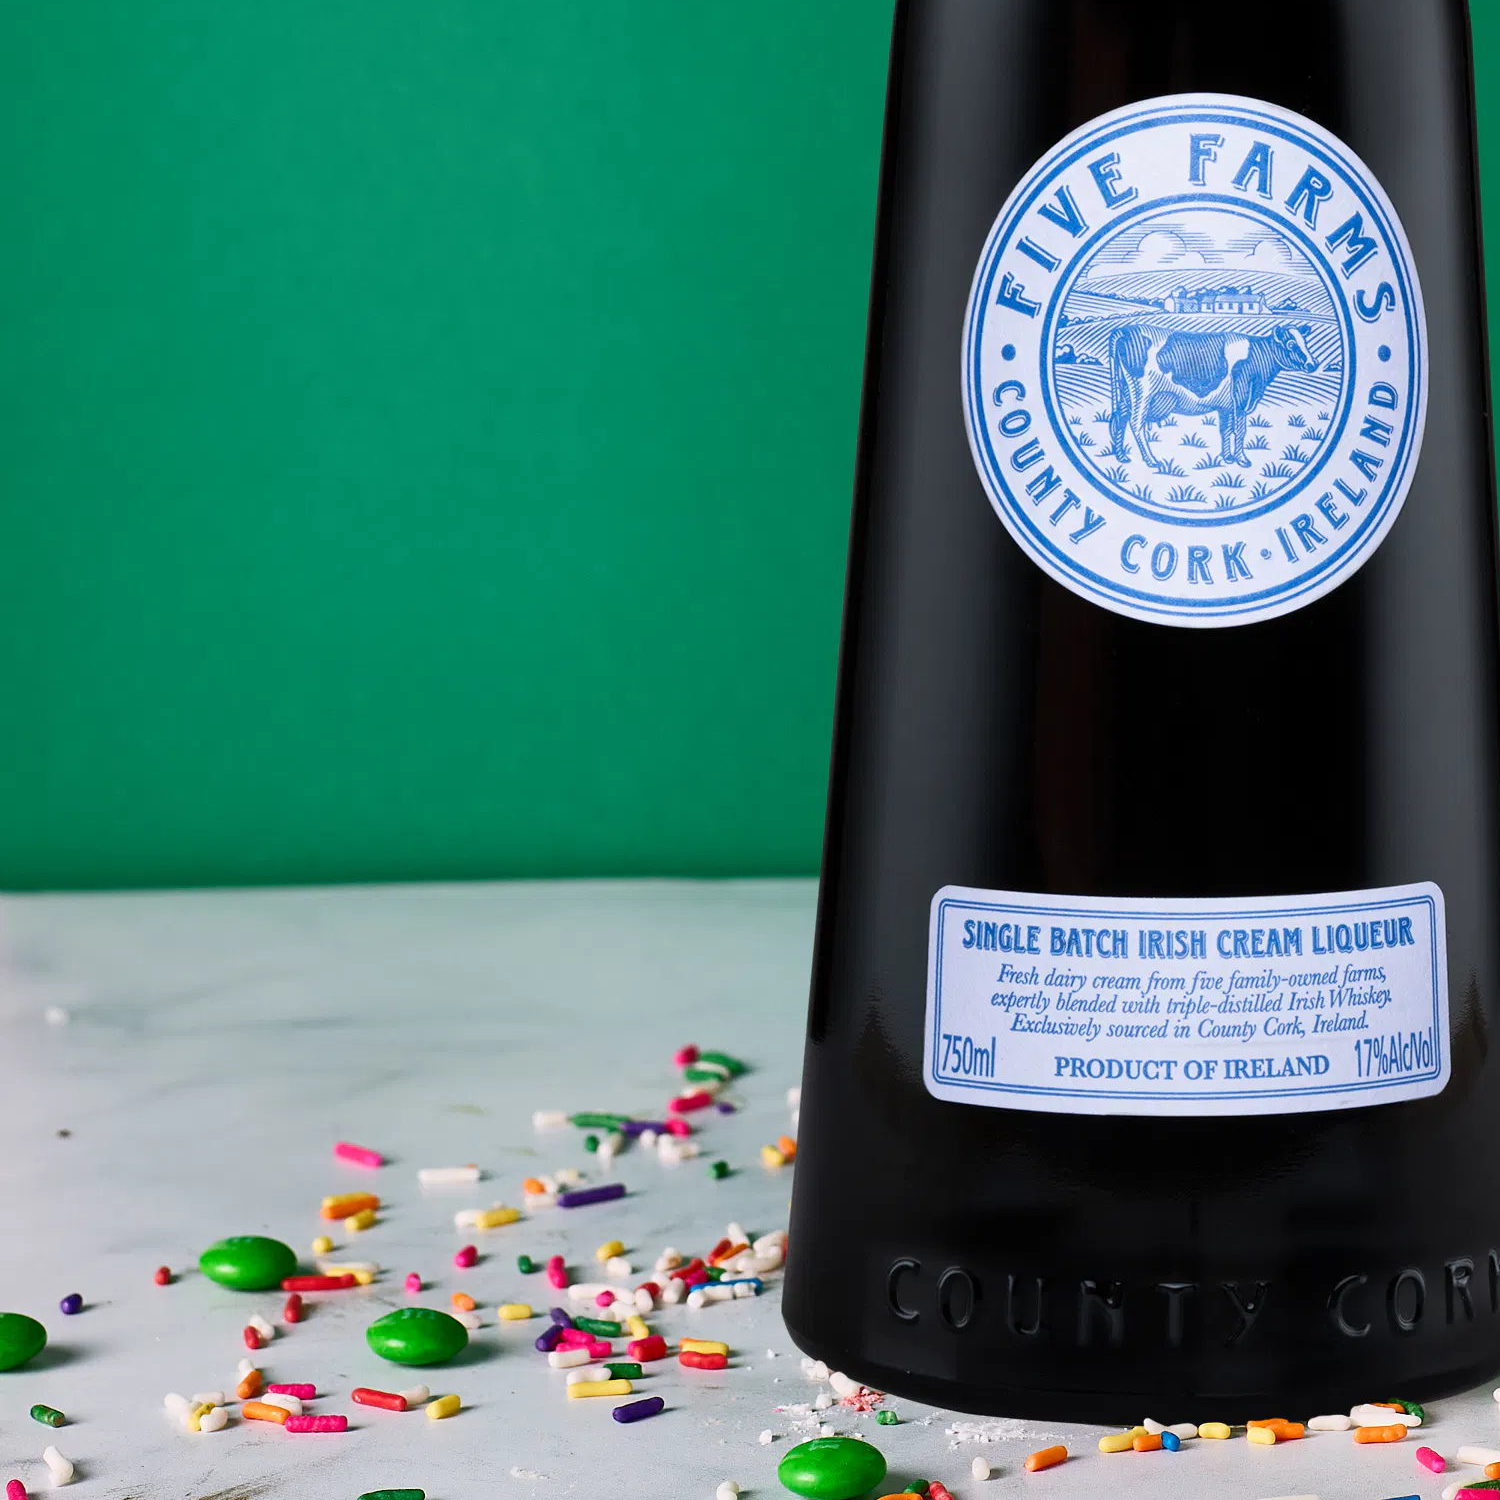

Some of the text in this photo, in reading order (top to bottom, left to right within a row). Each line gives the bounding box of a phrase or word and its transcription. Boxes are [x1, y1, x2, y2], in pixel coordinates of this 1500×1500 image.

[994, 132, 1397, 325] FIVE FARMS
[992, 379, 1399, 585] COUNTY CORK IRELAND
[962, 916, 1415, 960] SINGLE BATCH IRISH CREAM LIQUEUR
[996, 963, 1387, 996] Fresh dairy cream from five family-owned farms,
[990, 985, 1392, 1020] expertly blended with triple-distilled Irish Whiskey.
[1009, 1010, 1369, 1043] Exclusively sourced in County Cork, Ireland.
[941, 1033, 997, 1078] 750ml
[1053, 1054, 1331, 1081] PRODUCT OF IRELAND
[884, 1255, 1271, 1348] COUNTY
